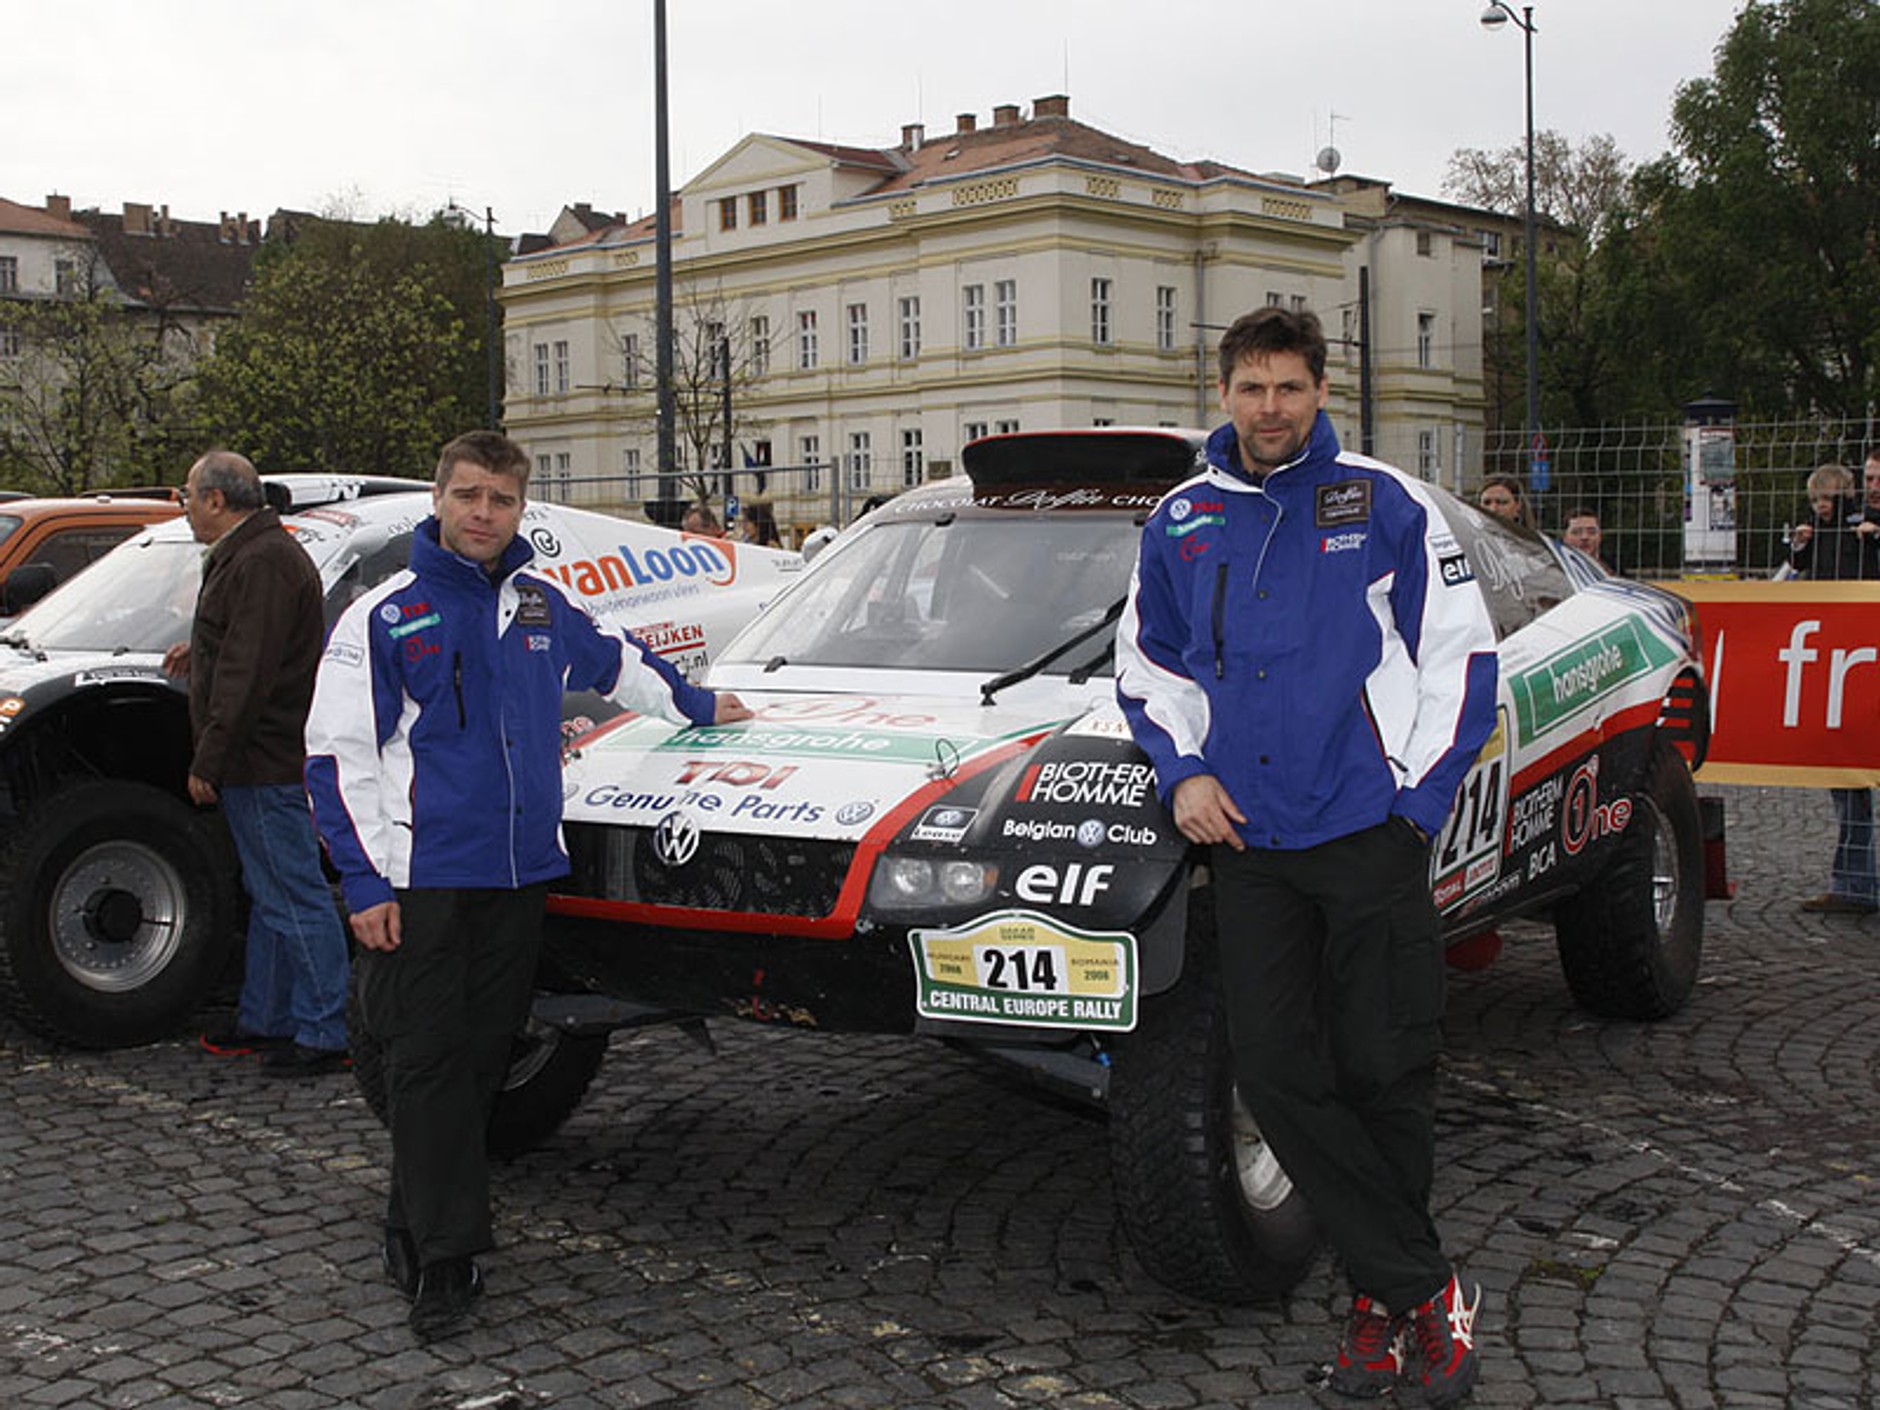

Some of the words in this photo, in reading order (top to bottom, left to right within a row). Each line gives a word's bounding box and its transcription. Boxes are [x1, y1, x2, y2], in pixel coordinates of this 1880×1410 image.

[1550, 637, 1623, 703] hansgrohe
[675, 761, 798, 790] TDI
[731, 795, 825, 822] Parts
[1030, 781, 1146, 807] HOMME
[1003, 819, 1076, 840] Belgian
[1107, 824, 1157, 845] Club
[1528, 841, 1557, 881] BCA
[1015, 863, 1114, 905] elf
[983, 949, 1056, 990] 214
[930, 990, 1000, 1013] CENTRAL
[1004, 998, 1068, 1018] EUROPE
[1073, 1002, 1122, 1020] RALLY
